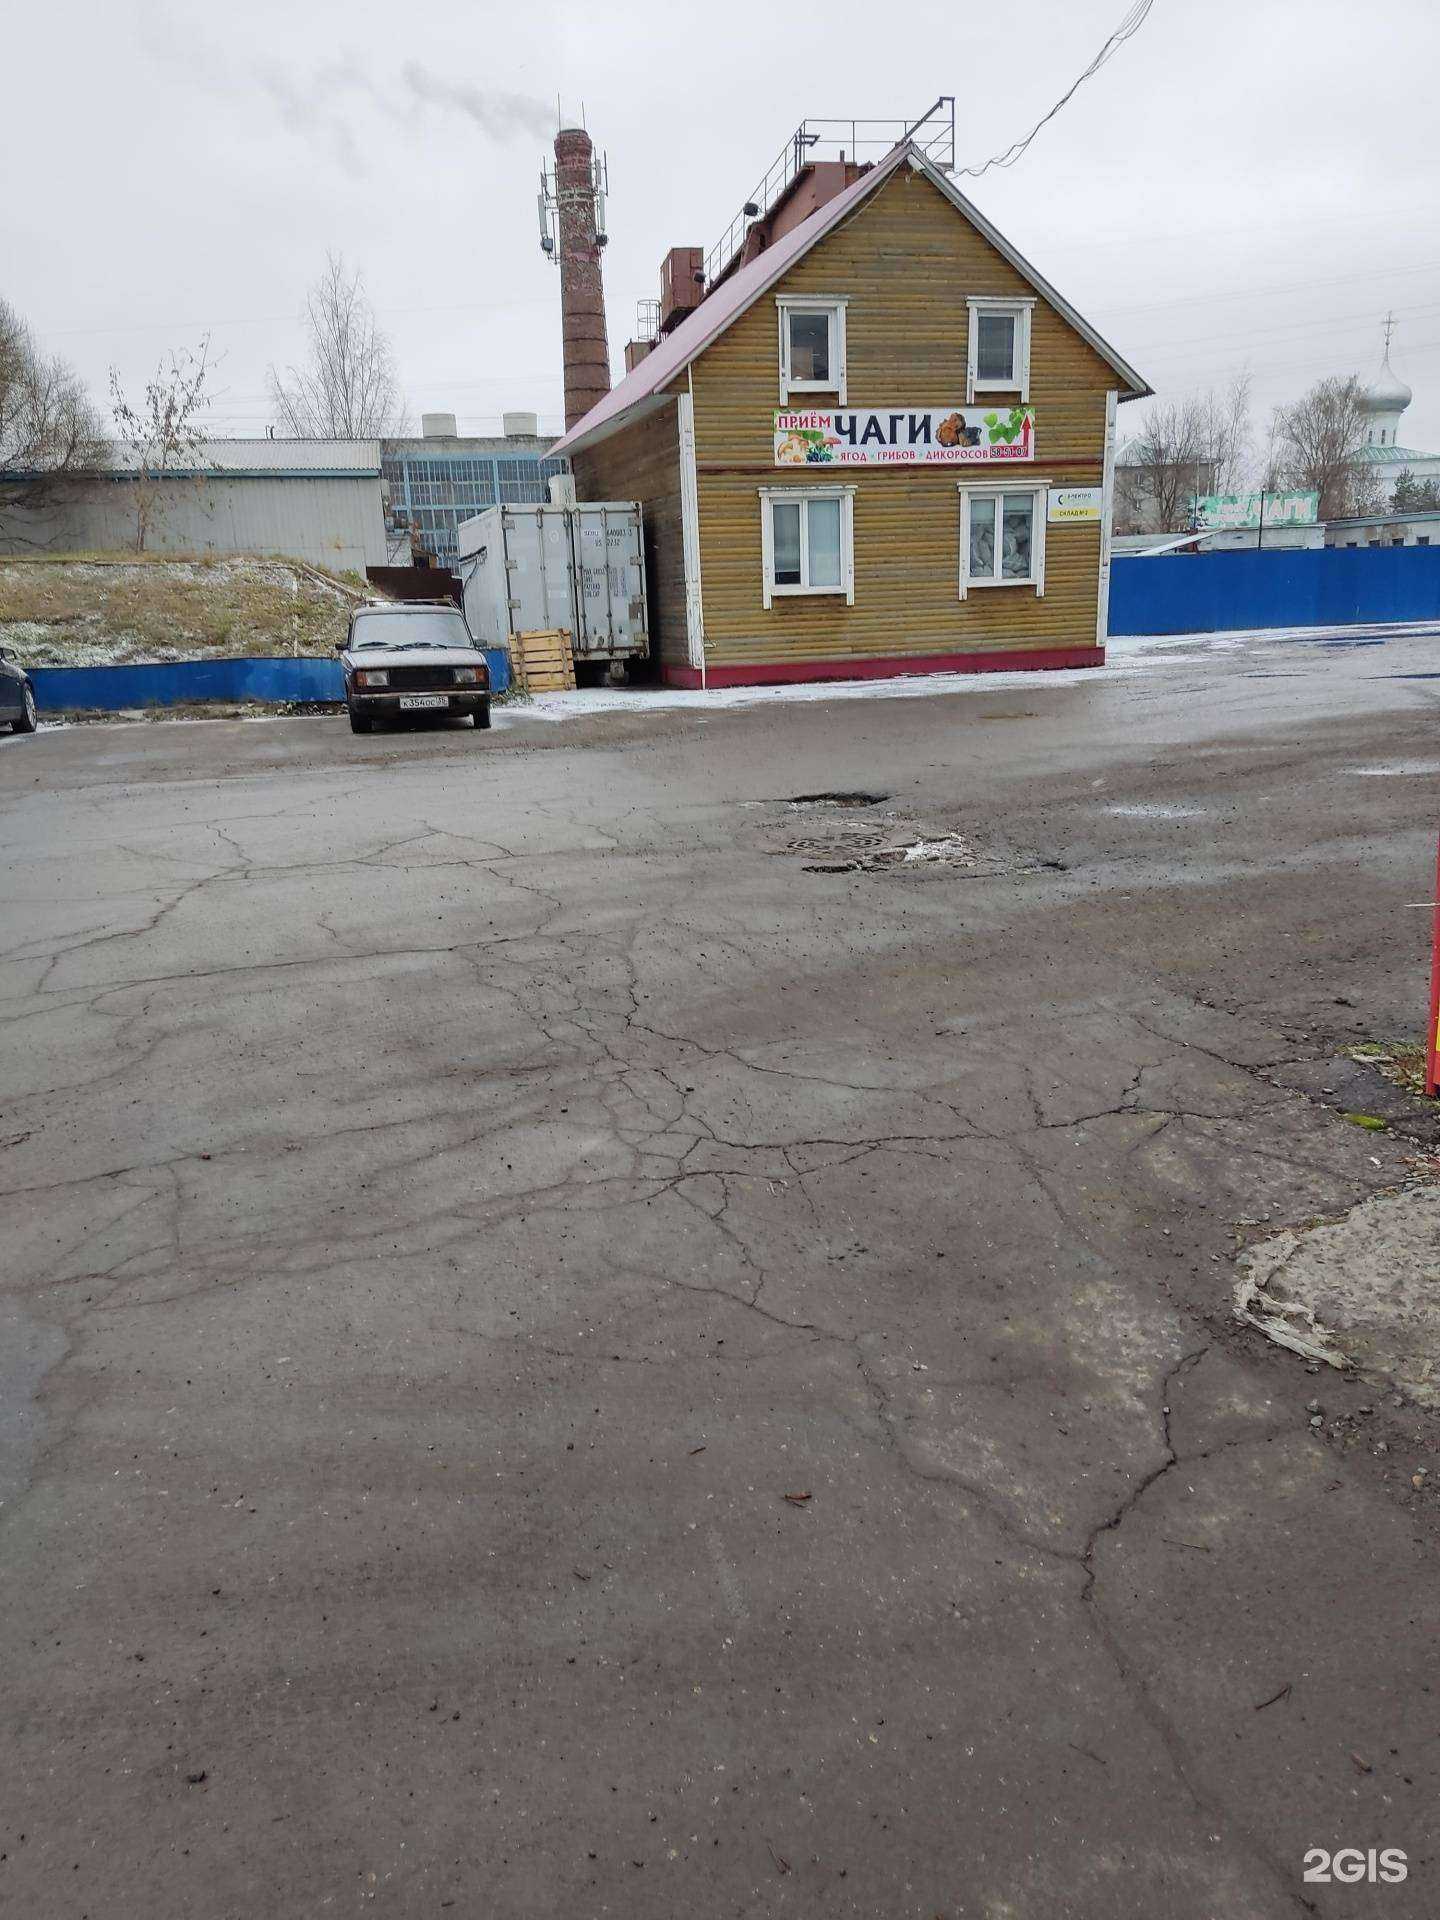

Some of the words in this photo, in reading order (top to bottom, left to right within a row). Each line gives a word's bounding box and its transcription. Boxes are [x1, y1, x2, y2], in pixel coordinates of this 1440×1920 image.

[778, 412, 831, 429] ПРИЁМ
[834, 413, 932, 446] ЧАГИ
[840, 451, 867, 462] ЯГОД
[877, 450, 916, 461] ГРИБОВ
[926, 449, 988, 460] ДИКОРОСОВ
